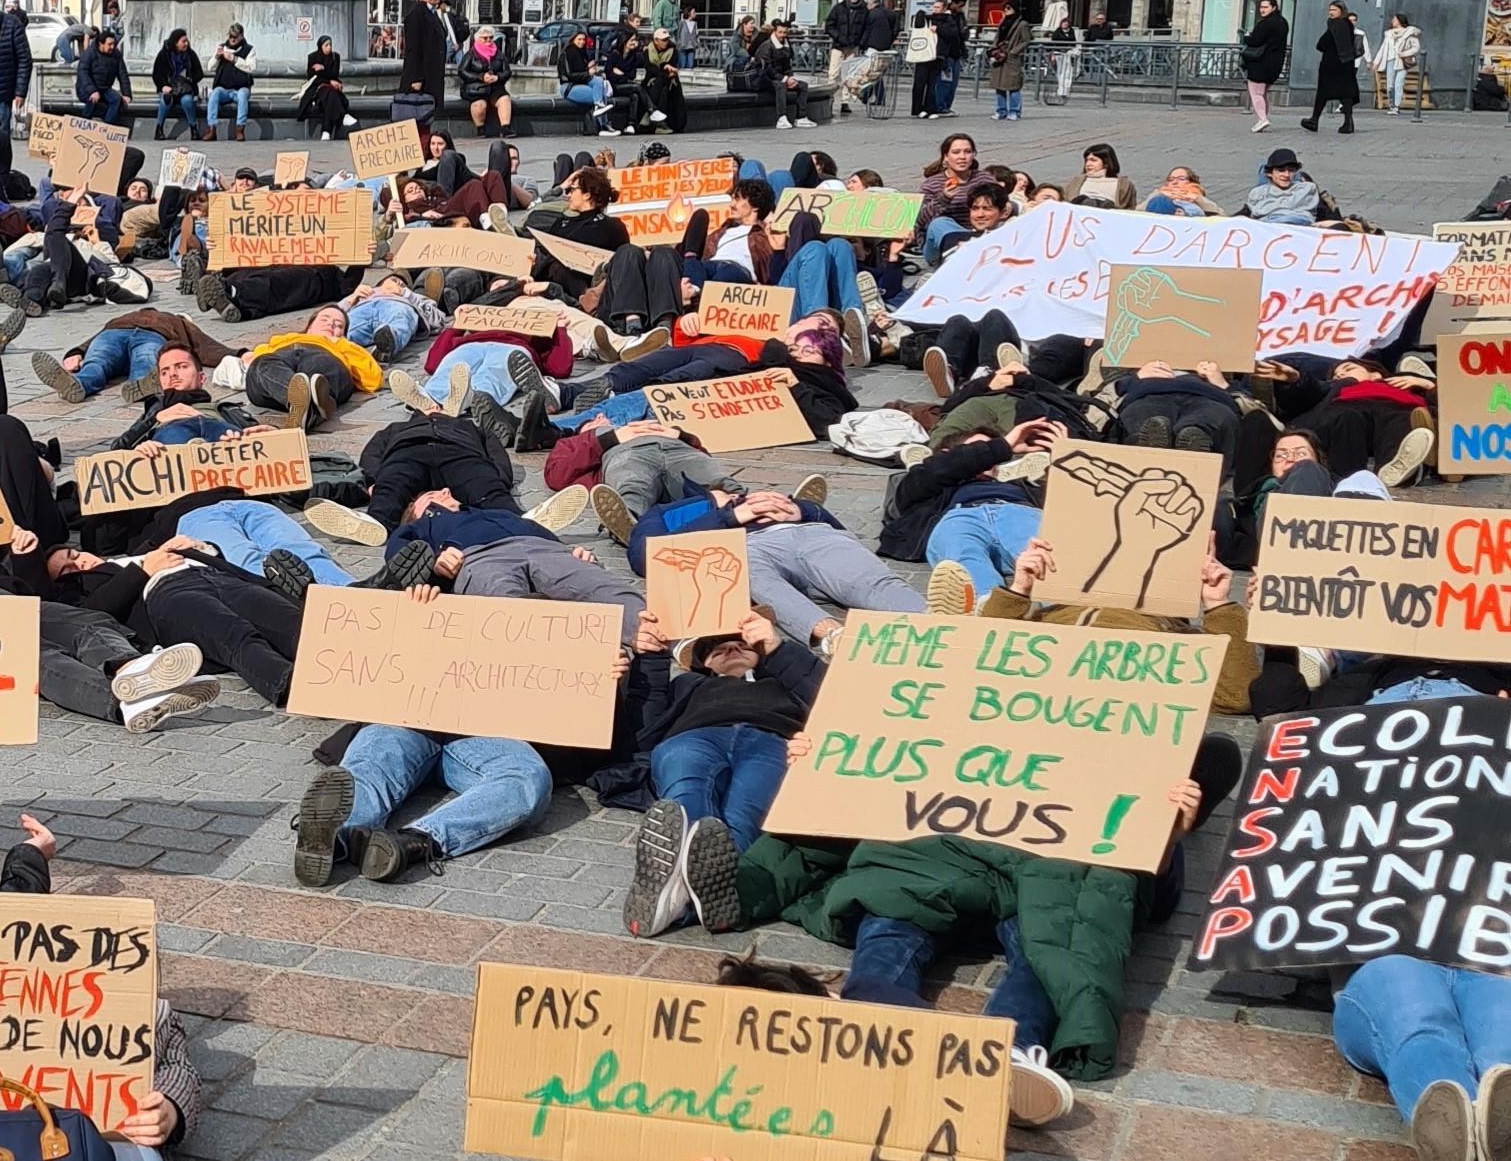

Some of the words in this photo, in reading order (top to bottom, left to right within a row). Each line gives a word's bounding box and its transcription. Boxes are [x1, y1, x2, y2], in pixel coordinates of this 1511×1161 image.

[356, 125, 409, 151] ARCHI
[359, 143, 421, 170] PRECAIRE
[621, 169, 641, 185] LE
[647, 159, 732, 182] MINISTERE
[230, 194, 255, 211] LE
[264, 192, 349, 215] SYSTEME
[619, 183, 673, 203] FERME
[697, 176, 733, 198] YEUX
[301, 215, 326, 236] UN
[229, 236, 340, 255] RAVALEMENT
[1458, 247, 1497, 263] ANS
[1447, 264, 1466, 277] OS
[721, 286, 768, 307] ARCHI
[463, 317, 545, 332] FAUCHE
[704, 305, 781, 332] PRÉCAIRE
[651, 388, 676, 403] ON
[682, 385, 711, 399] VEUT
[657, 404, 686, 421] PAS
[691, 395, 785, 420] S'ENDETTER
[197, 440, 269, 465] DÉTER
[83, 454, 186, 505] ARCHI
[1270, 516, 1400, 557] MAQUETTES
[1402, 524, 1439, 559] EN
[1259, 565, 1377, 620] BIENTÔT
[1380, 581, 1437, 629] VOS
[324, 601, 384, 635] PAS
[423, 610, 466, 640] DE
[480, 609, 618, 644] CULTURE
[848, 615, 958, 670] MÊME
[976, 629, 1059, 679] LES
[1068, 639, 1214, 685] ARBRES
[307, 648, 406, 685] SANS
[438, 658, 608, 698] ARCHITECTURE
[882, 679, 946, 720] SE
[969, 685, 1198, 746] BOUGENT
[1265, 705, 1511, 762] ECOL
[814, 731, 945, 784] PLUS
[954, 745, 1065, 792] QUE
[905, 789, 1073, 845] VOUS
[1230, 794, 1461, 858] SANS
[1, 920, 81, 962] PAS
[81, 925, 152, 974] DES
[59, 1017, 153, 1066] NOUS
[653, 997, 707, 1043] NE
[736, 1004, 915, 1068] RESTONS
[936, 1032, 1006, 1080] PAS
[524, 1049, 836, 1138] plantées
